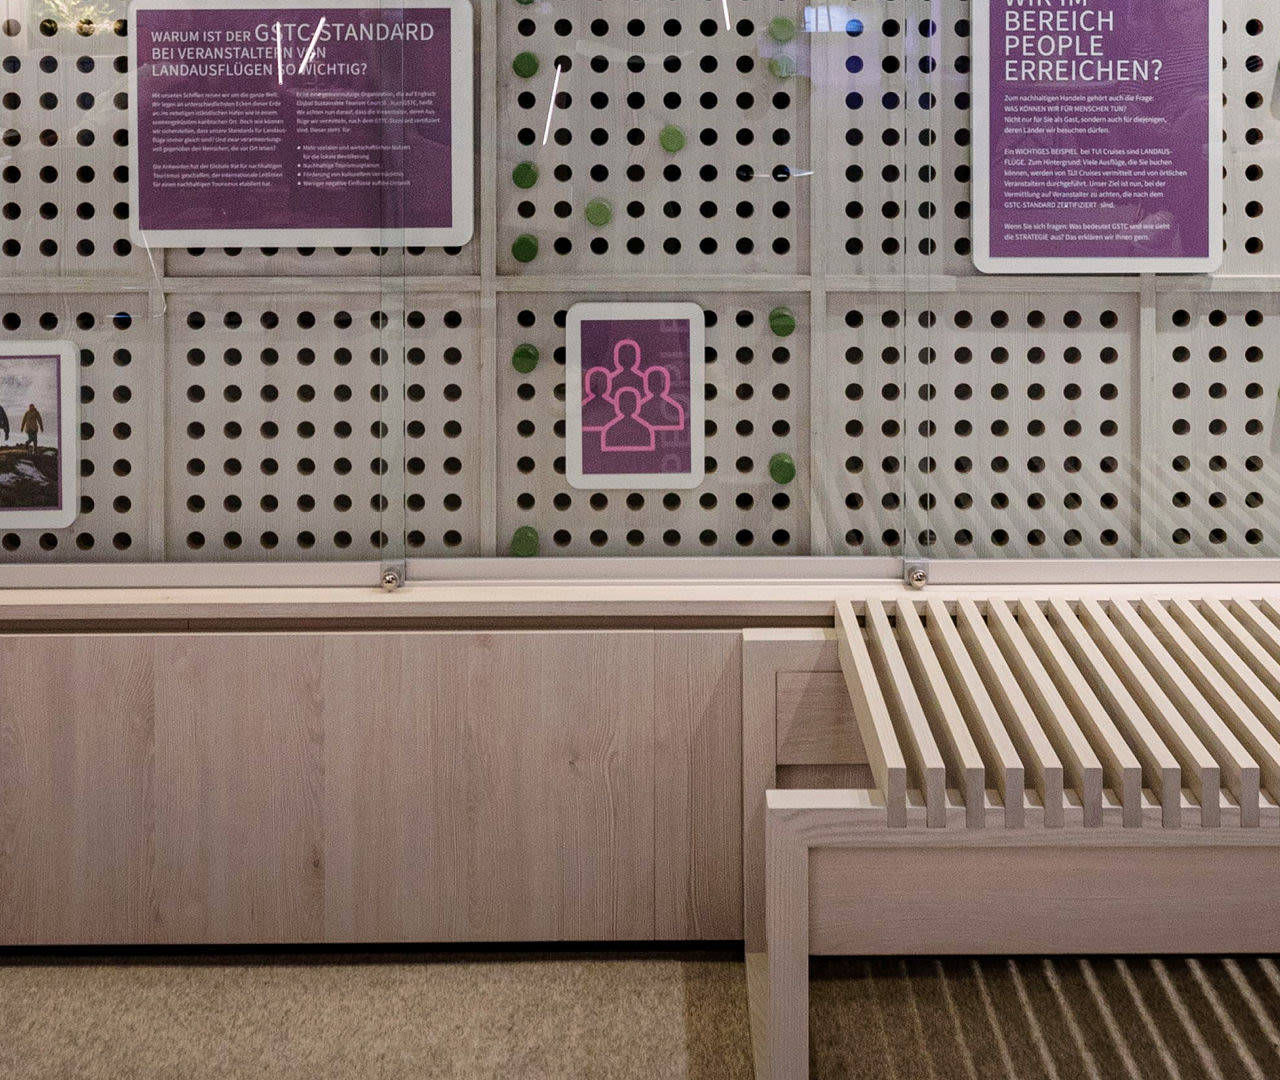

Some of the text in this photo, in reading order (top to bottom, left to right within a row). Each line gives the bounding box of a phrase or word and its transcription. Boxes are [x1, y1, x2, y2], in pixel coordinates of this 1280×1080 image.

[1005, 10, 1114, 32] BEREICH
[151, 31, 199, 42] WARUM
[203, 31, 222, 42] IST
[226, 30, 251, 42] DER
[152, 47, 174, 59] BEI
[178, 47, 293, 59] VERANSTALTERN
[1005, 35, 1103, 56] PEOPLE
[152, 61, 273, 76] LANDAUSFLÜGEN
[1005, 59, 1163, 81] ERREICHEN?
